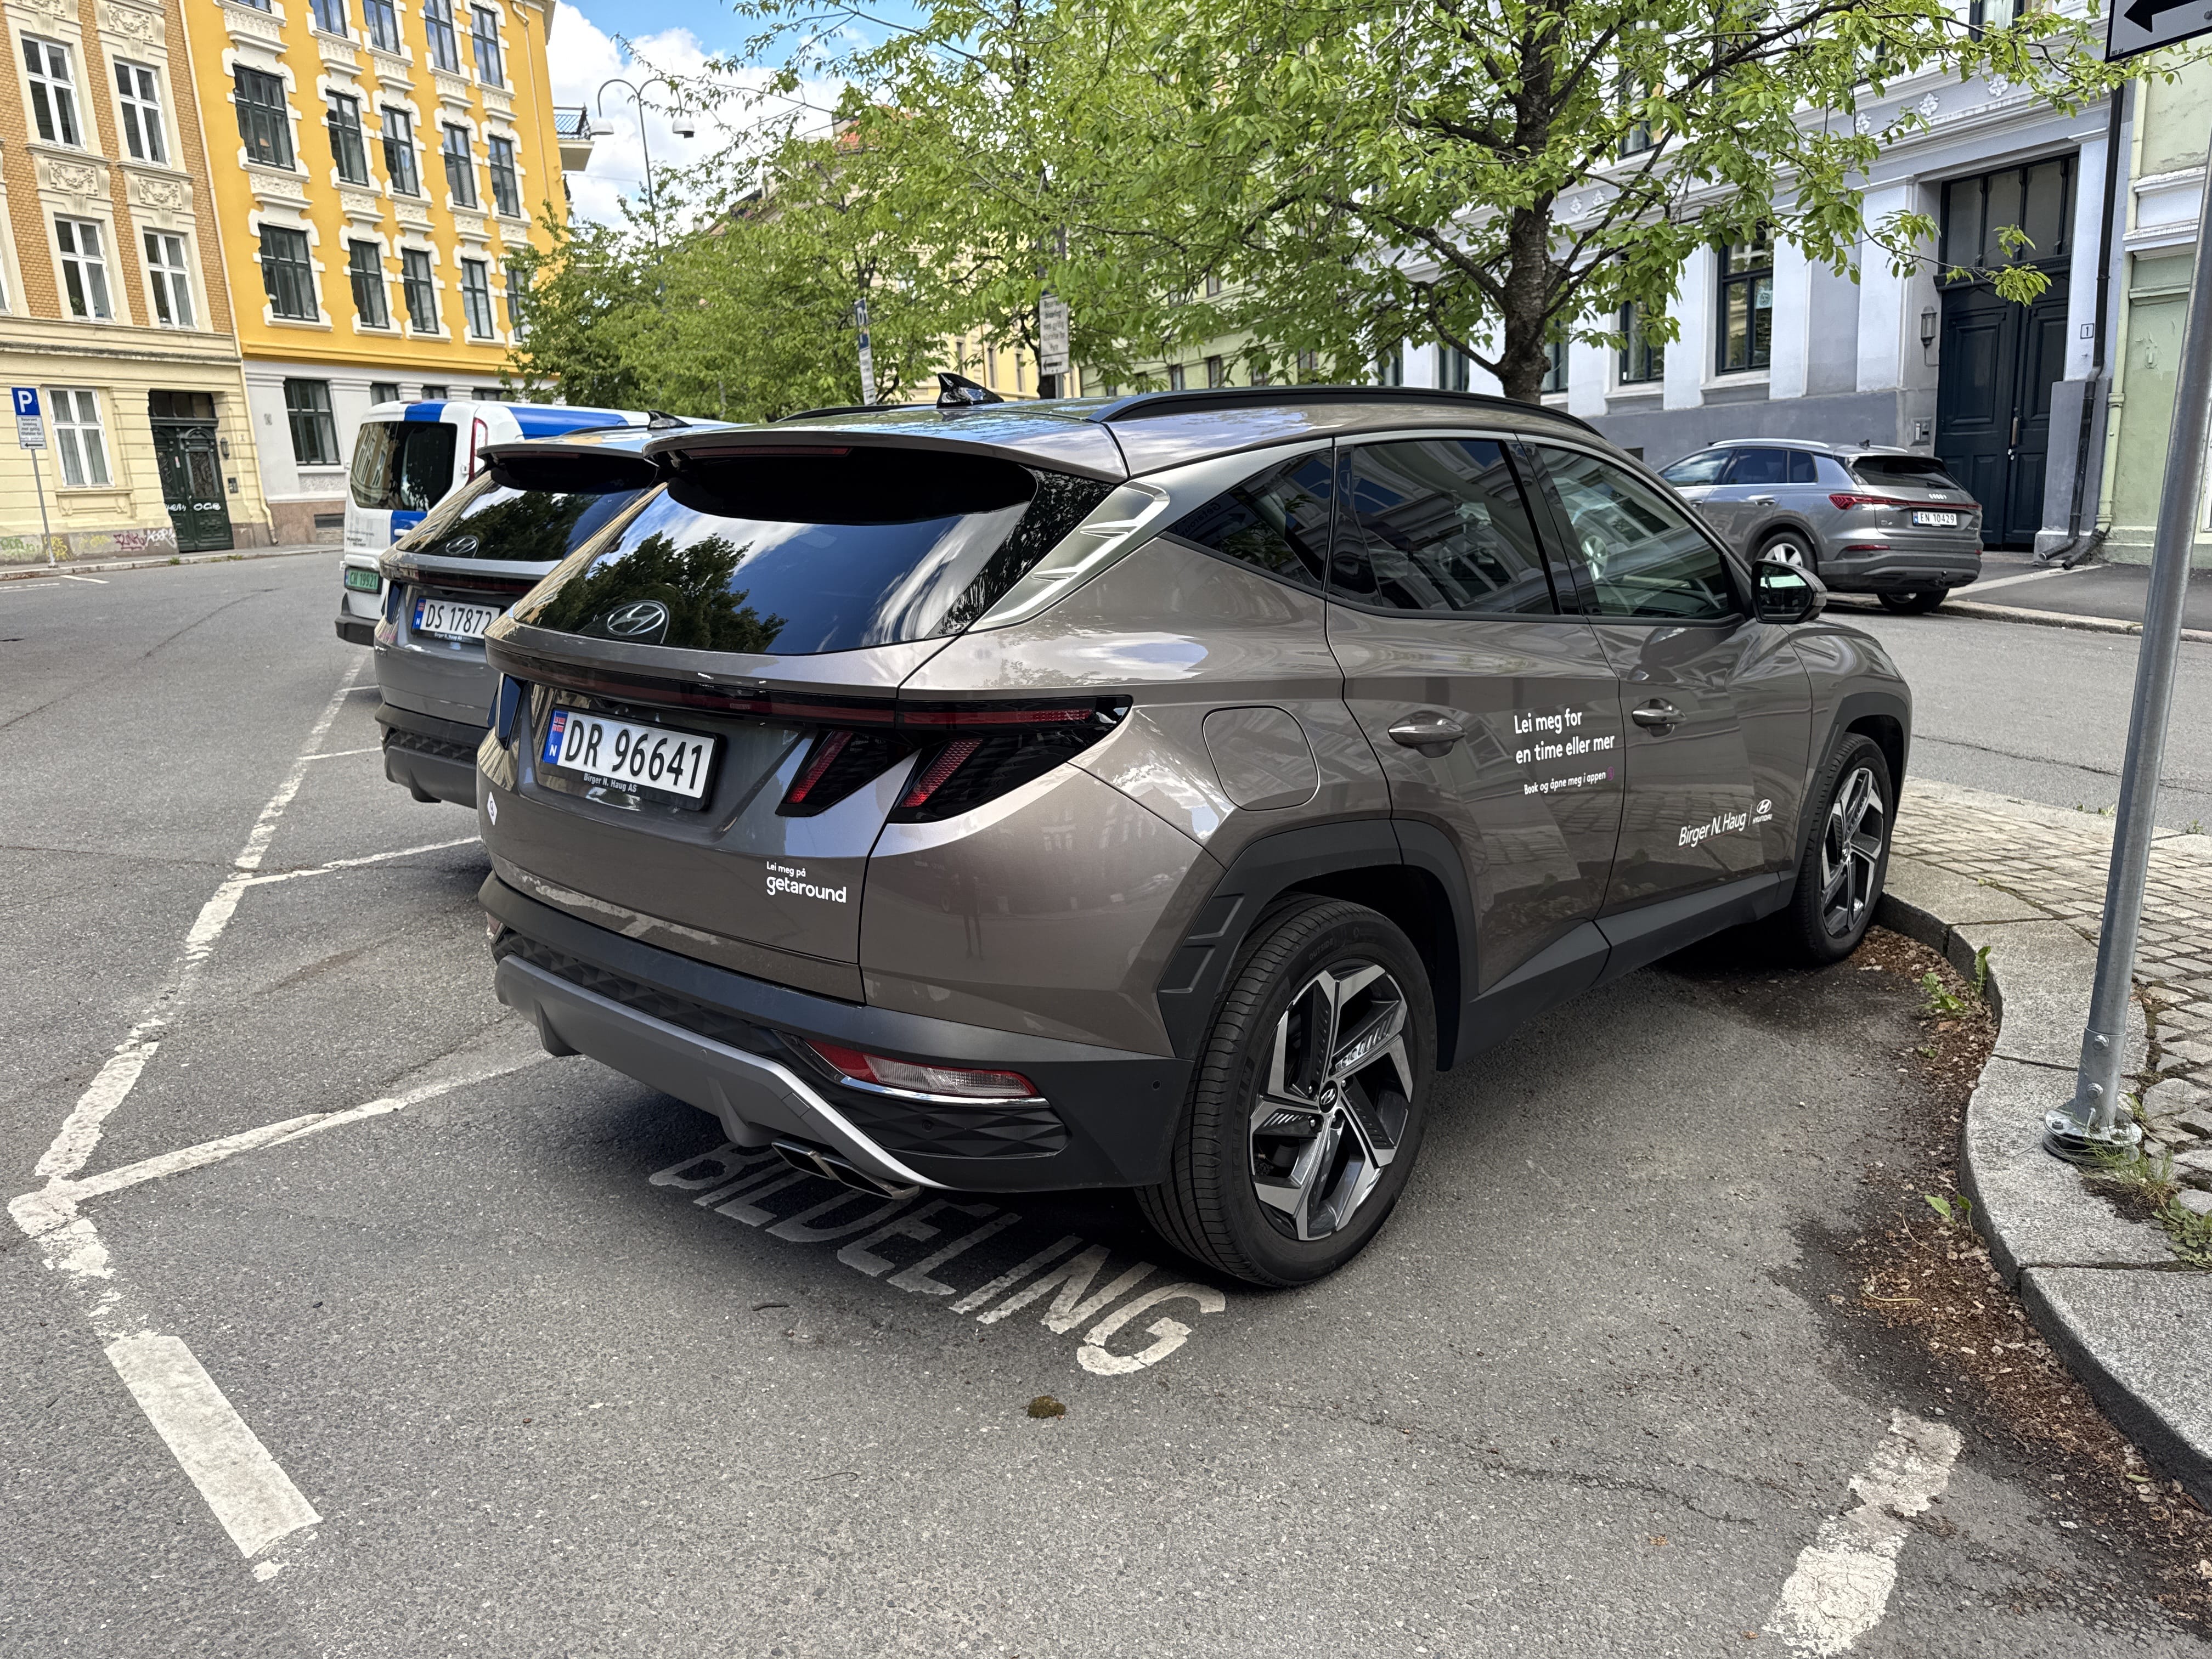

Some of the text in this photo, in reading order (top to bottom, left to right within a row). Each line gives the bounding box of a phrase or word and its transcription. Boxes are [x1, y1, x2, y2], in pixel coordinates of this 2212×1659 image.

[2085, 326, 2089, 337] 1
[18, 390, 33, 413] P
[1933, 514, 1955, 523] 10429
[349, 572, 377, 588] CH 19921
[425, 604, 492, 635] DS 17872
[1514, 708, 1582, 734] Lei meg for
[549, 744, 557, 757] N
[565, 720, 703, 790] DR 96641
[1516, 735, 1615, 764] en time eller mer
[583, 772, 637, 793] Birger N. Haug AS
[1523, 771, 1606, 795] Book og åpne meg i appen
[1678, 812, 1747, 848] Birger N. Haug
[1752, 813, 1773, 825] HYUNDAI
[766, 861, 806, 878] Lei meg på
[766, 876, 847, 903] getaround
[1308, 938, 1335, 961] OUTSIDE
[1232, 1065, 1254, 1199] MICHELIN
[648, 1142, 1226, 1376] BILDELING
